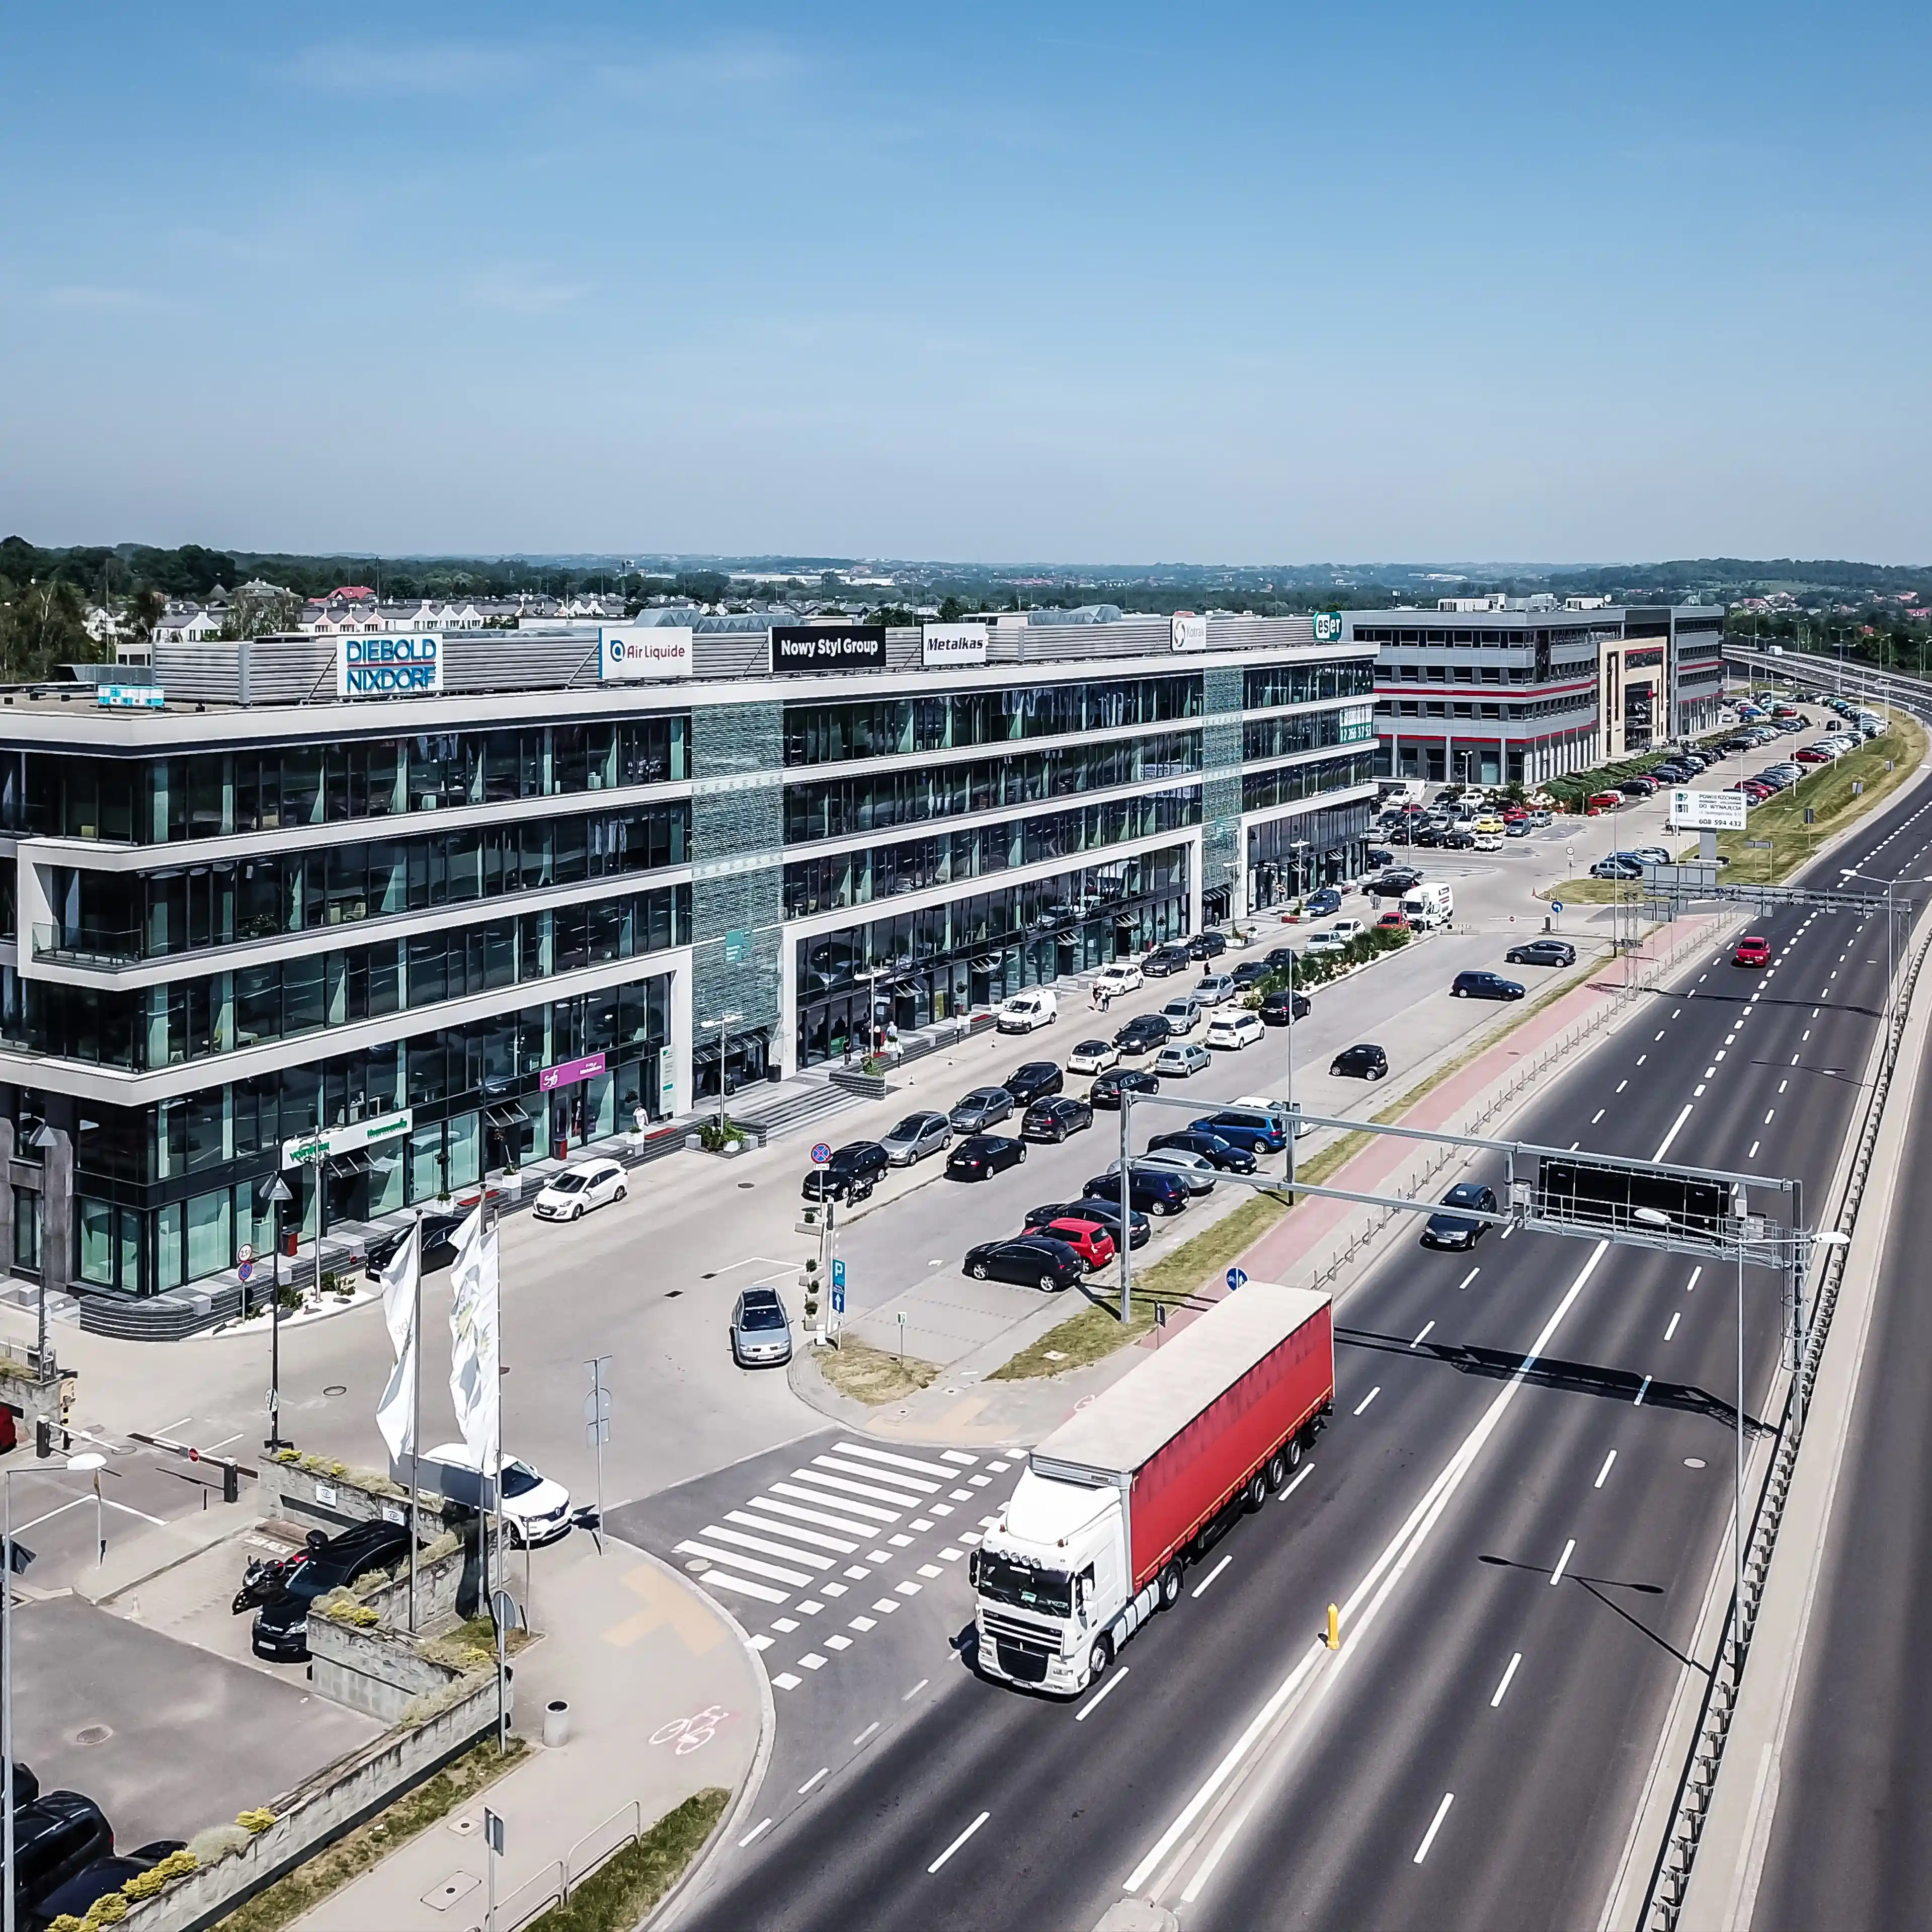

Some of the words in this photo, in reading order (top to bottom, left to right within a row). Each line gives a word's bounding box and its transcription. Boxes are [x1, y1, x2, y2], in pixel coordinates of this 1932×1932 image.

[347, 638, 436, 663] DIEBOLD
[627, 645, 642, 659] Air
[645, 645, 685, 661] Liquide
[781, 639, 815, 658] Nowy
[818, 638, 841, 657] Styl
[843, 638, 878, 655] Group
[927, 637, 983, 651] Metalkas
[347, 666, 436, 694] NIXDORF
[835, 1261, 843, 1277] P
